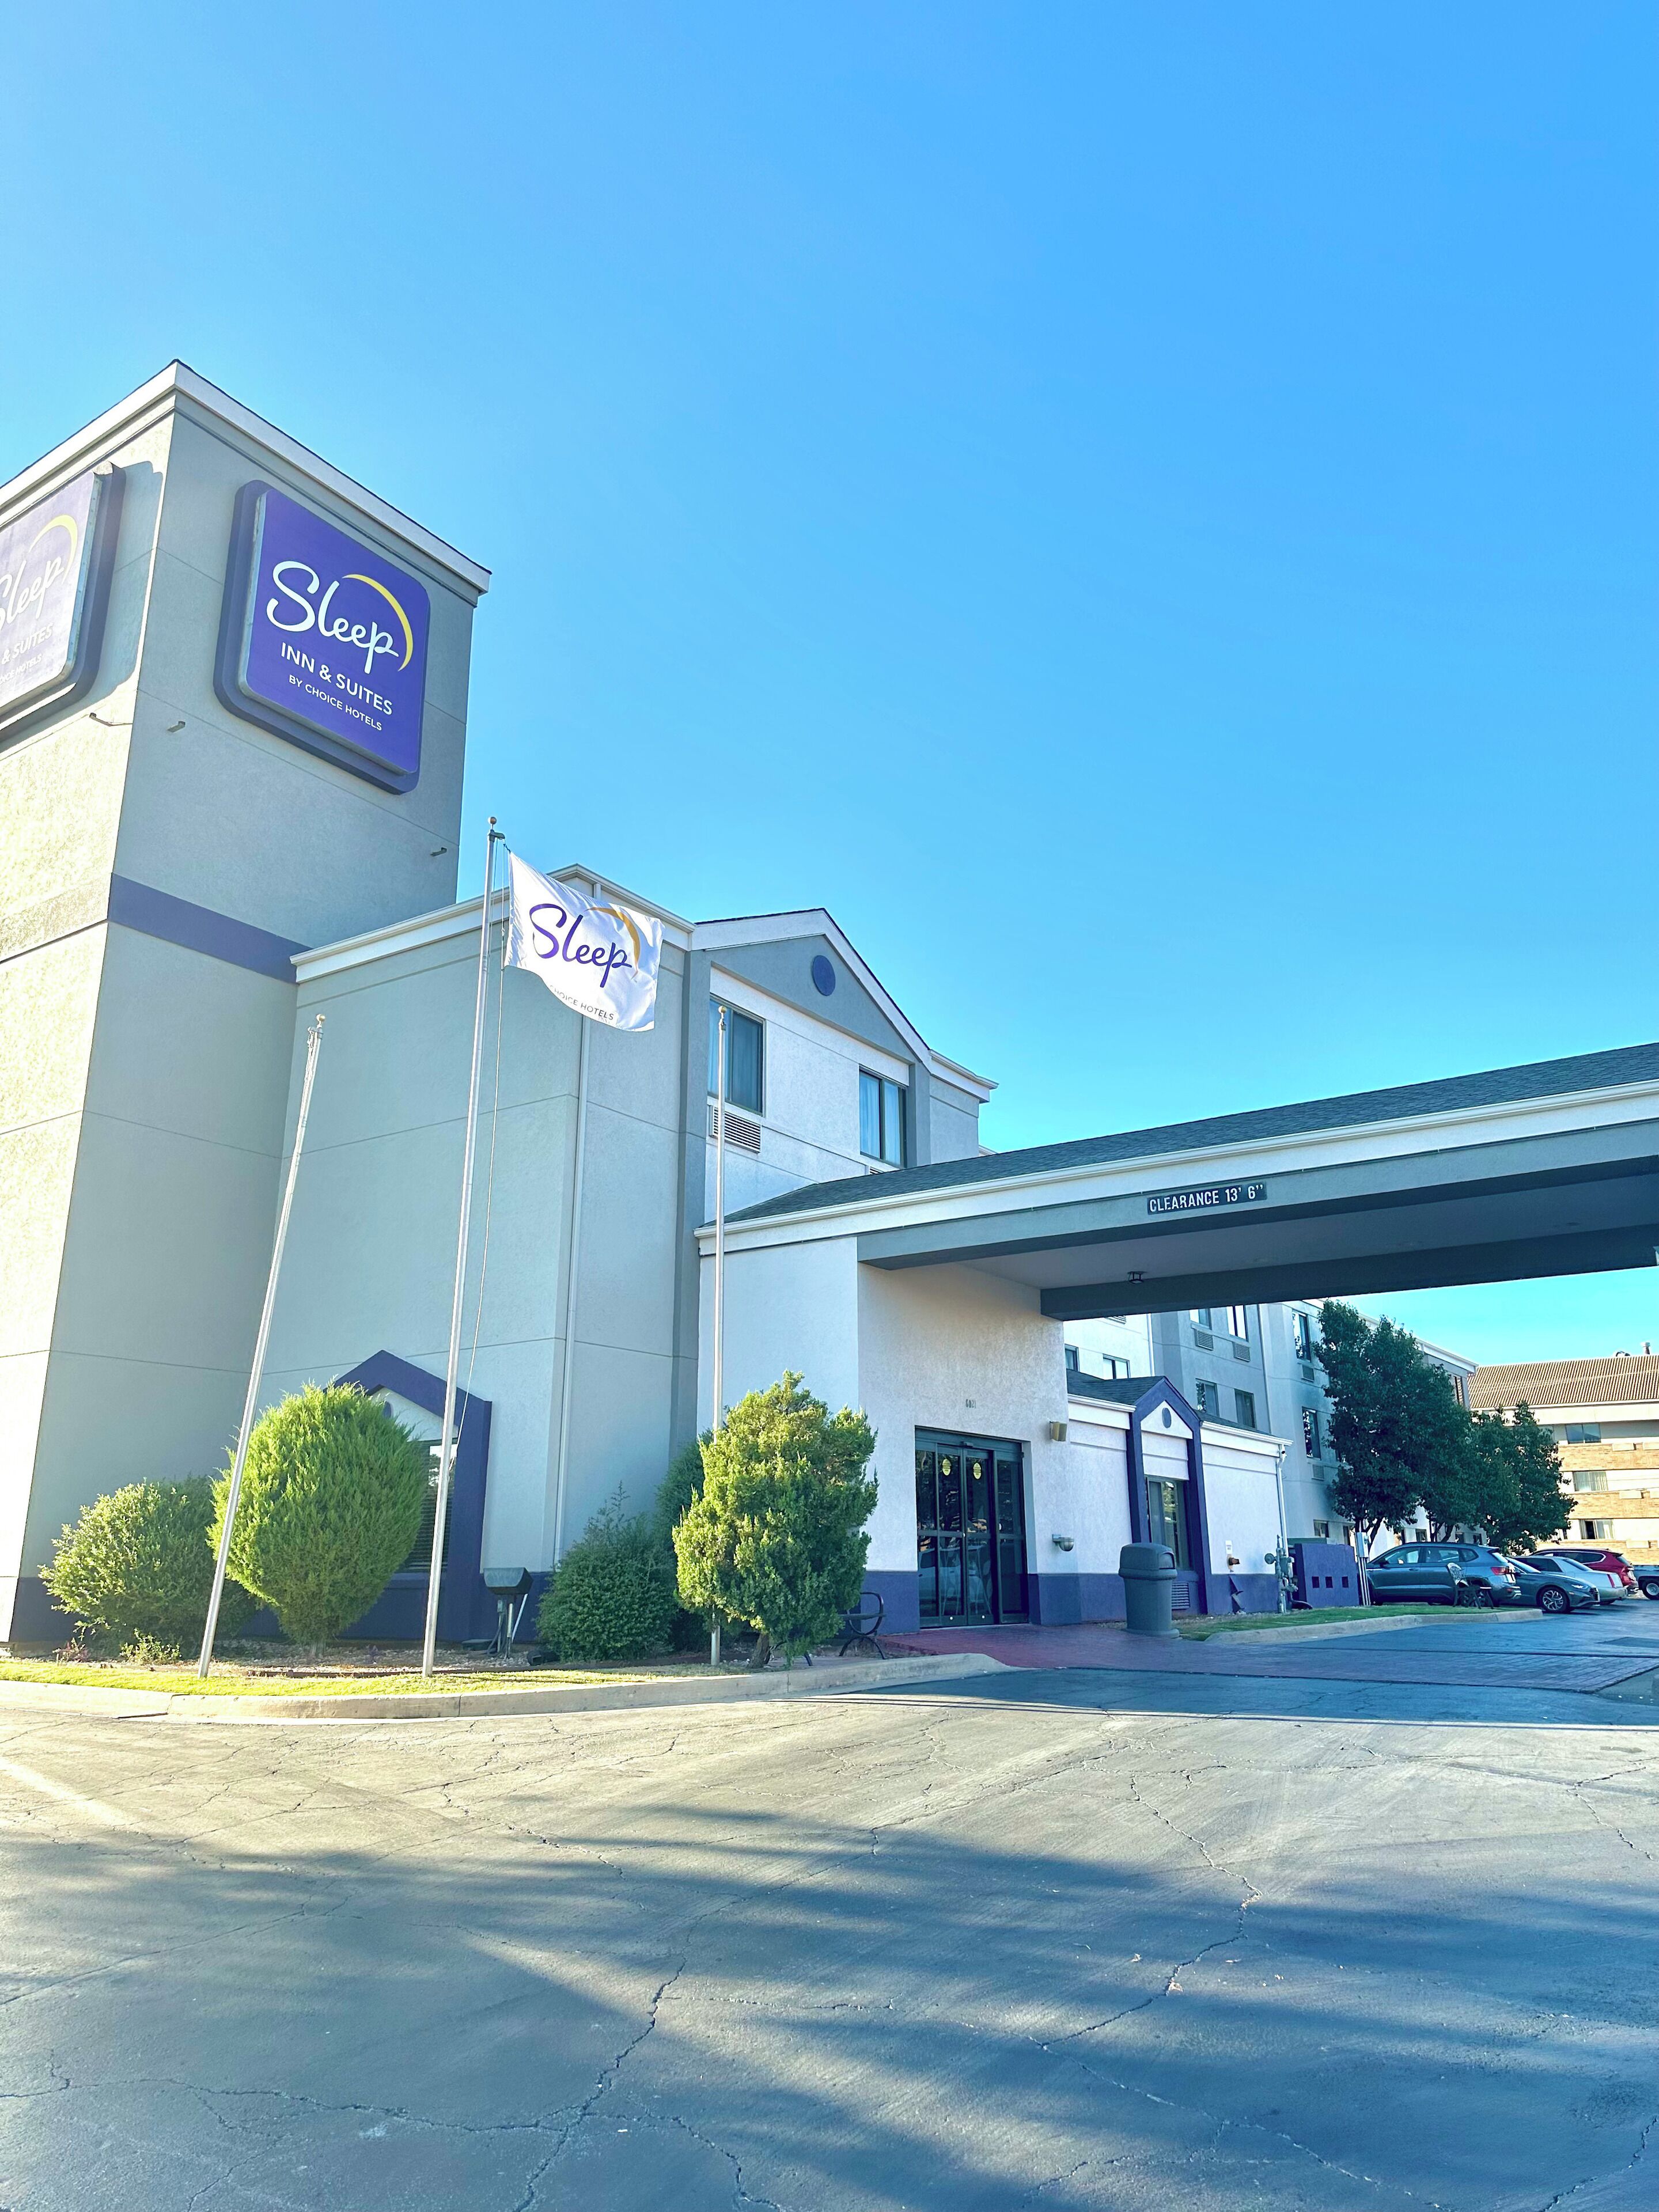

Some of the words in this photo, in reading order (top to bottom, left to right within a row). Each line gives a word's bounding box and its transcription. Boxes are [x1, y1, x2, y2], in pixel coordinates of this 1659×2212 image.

[266, 560, 399, 674] Sleep
[2, 649, 11, 665] &
[12, 623, 54, 659] SUITES
[15, 653, 43, 675] HOTELS
[281, 642, 315, 673] INN
[319, 664, 332, 683] &
[336, 673, 393, 715] SUITES
[289, 674, 303, 688] BY
[305, 684, 343, 710] CHOICE
[345, 704, 382, 731] HOTELS
[529, 903, 632, 988] Sleep
[580, 1002, 615, 1021] HOTELS
[1149, 1190, 1220, 1213] CLEARANCE
